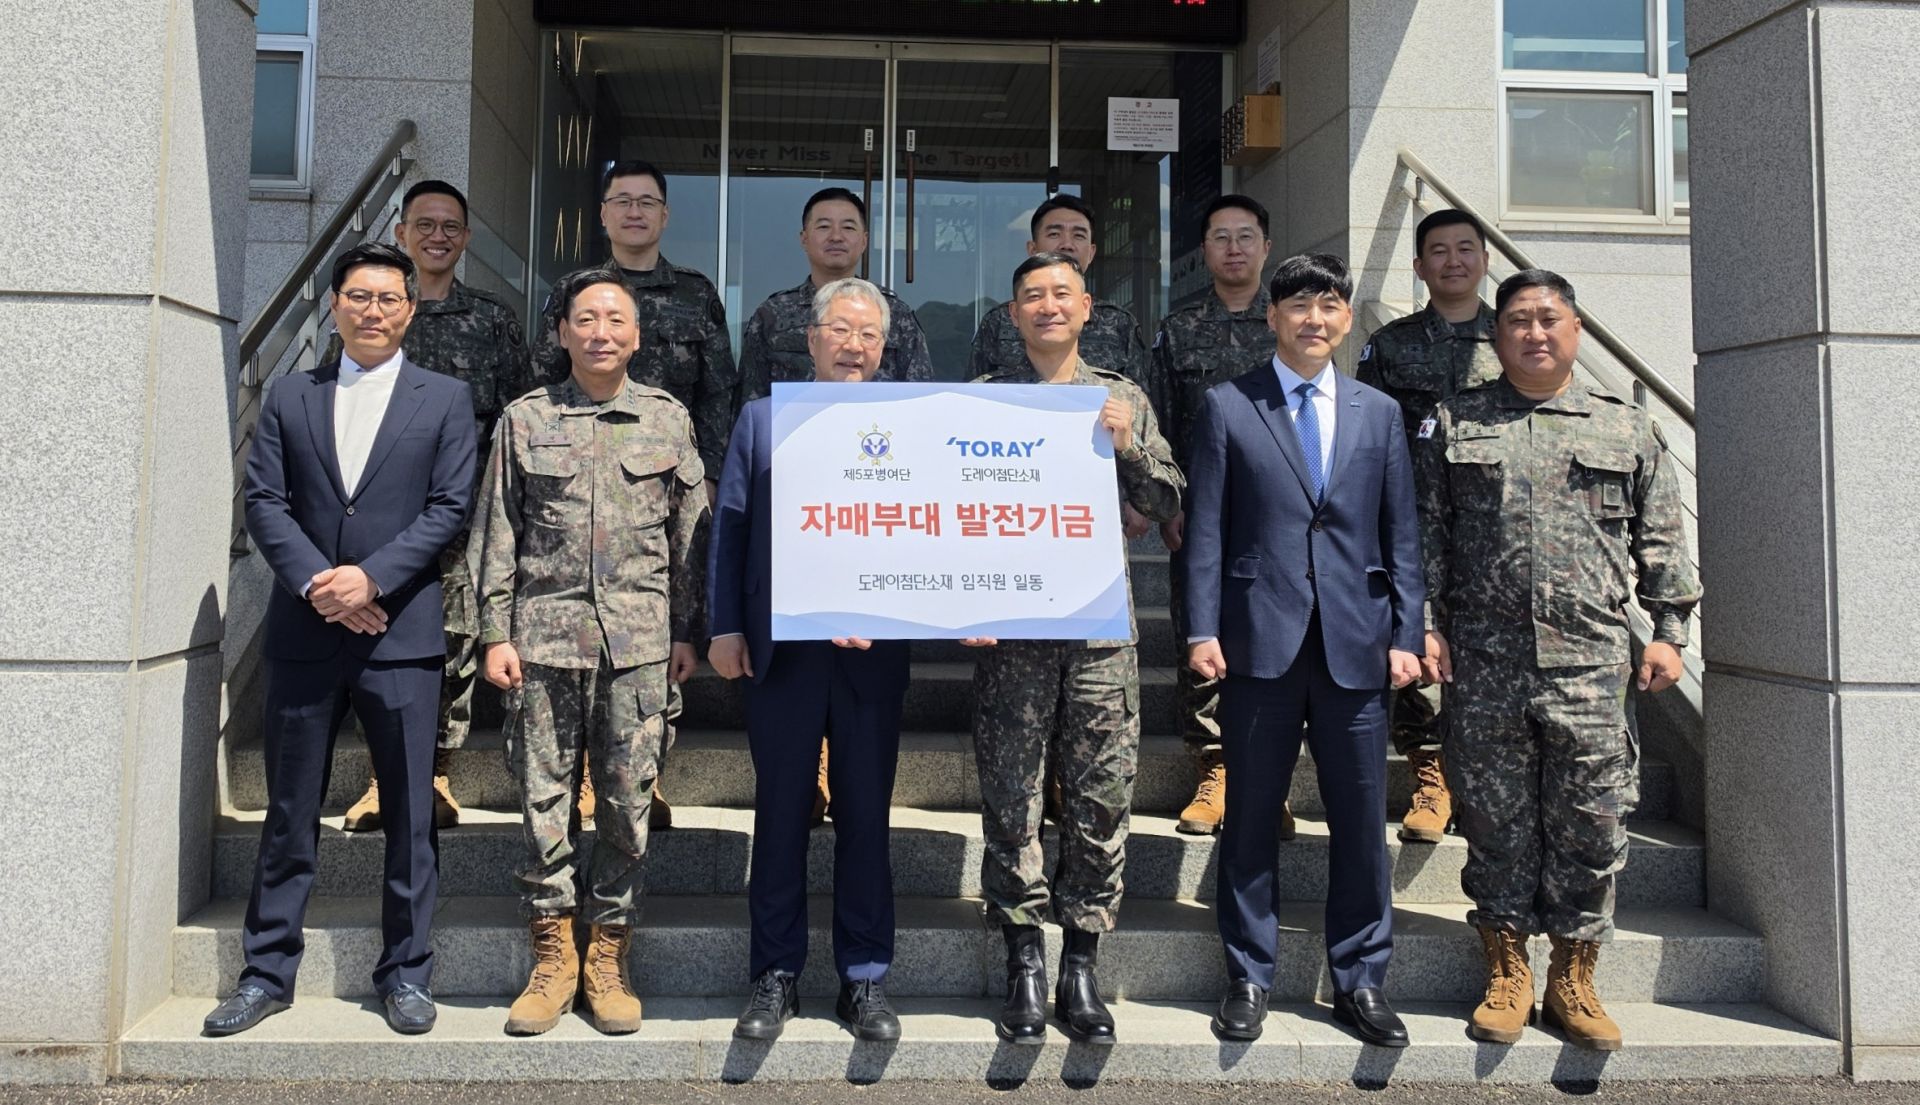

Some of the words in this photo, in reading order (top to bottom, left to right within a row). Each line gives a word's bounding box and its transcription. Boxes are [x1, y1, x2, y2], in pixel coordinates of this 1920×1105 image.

[703, 143, 767, 161] Nver
[778, 145, 831, 162] Miss
[950, 151, 1030, 171] Target!
[844, 468, 911, 482] 제5포병여단
[800, 502, 941, 538] 자매부대
[957, 502, 1095, 538] 발전기금
[858, 573, 953, 592] 도레이첨단소재
[961, 573, 1007, 592] 임직원
[1013, 573, 1044, 592] 일동
